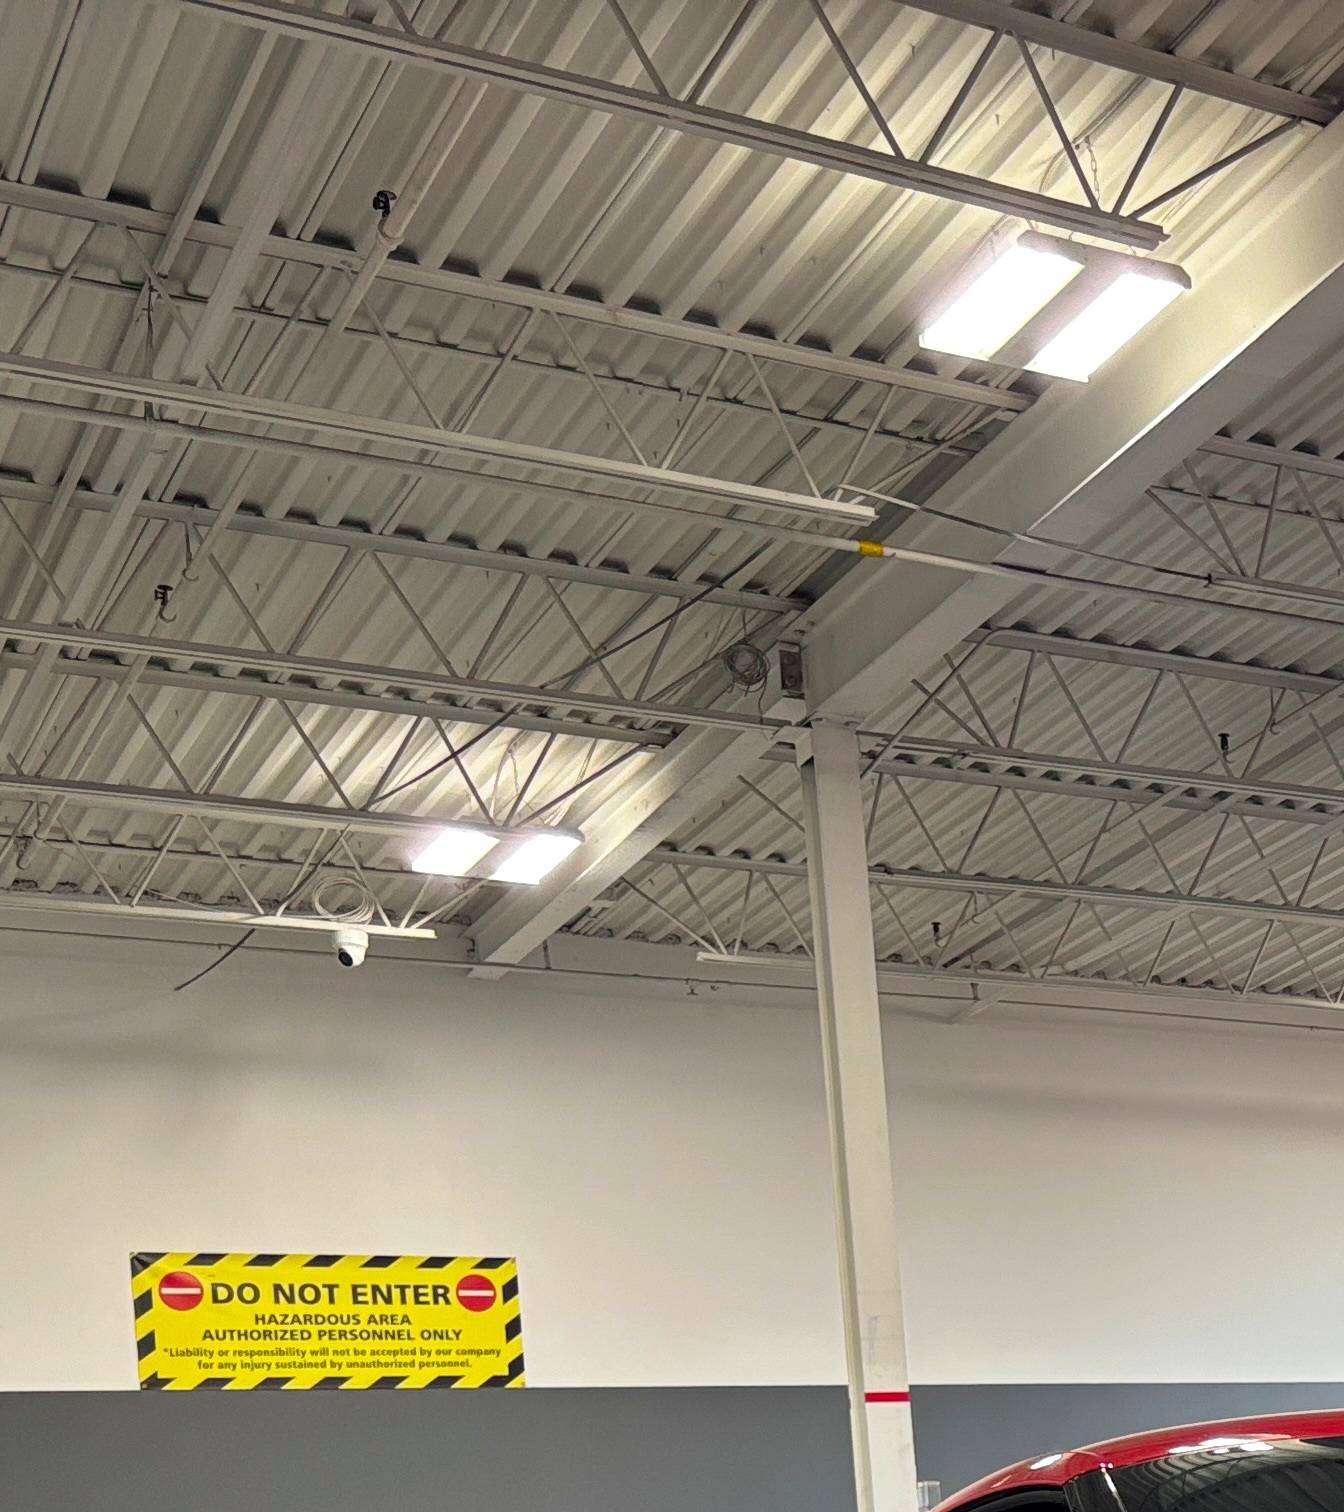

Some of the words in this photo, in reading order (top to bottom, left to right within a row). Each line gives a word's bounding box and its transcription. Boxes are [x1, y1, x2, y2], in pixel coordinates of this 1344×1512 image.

[211, 1282, 261, 1305] DO
[272, 1283, 340, 1305] NOT
[351, 1283, 451, 1306] ENTER
[254, 1313, 361, 1326] HAZARDOUS
[367, 1314, 412, 1326] AREA
[202, 1329, 312, 1341] AUTHORIZED
[317, 1329, 415, 1341] PERSONNEL
[420, 1329, 463, 1341] ONLY
[233, 1347, 306, 1359] responsibility
[310, 1347, 329, 1357] will
[332, 1347, 350, 1357] not
[353, 1347, 366, 1357] be
[370, 1347, 417, 1358] accepted
[420, 1347, 432, 1358] by
[435, 1349, 452, 1357] our
[455, 1349, 501, 1358] company
[198, 1360, 214, 1370] for
[217, 1362, 238, 1371] any
[240, 1360, 272, 1371] injury
[275, 1360, 327, 1370] sustained
[330, 1359, 343, 1370] by
[346, 1359, 416, 1369] unauthorized
